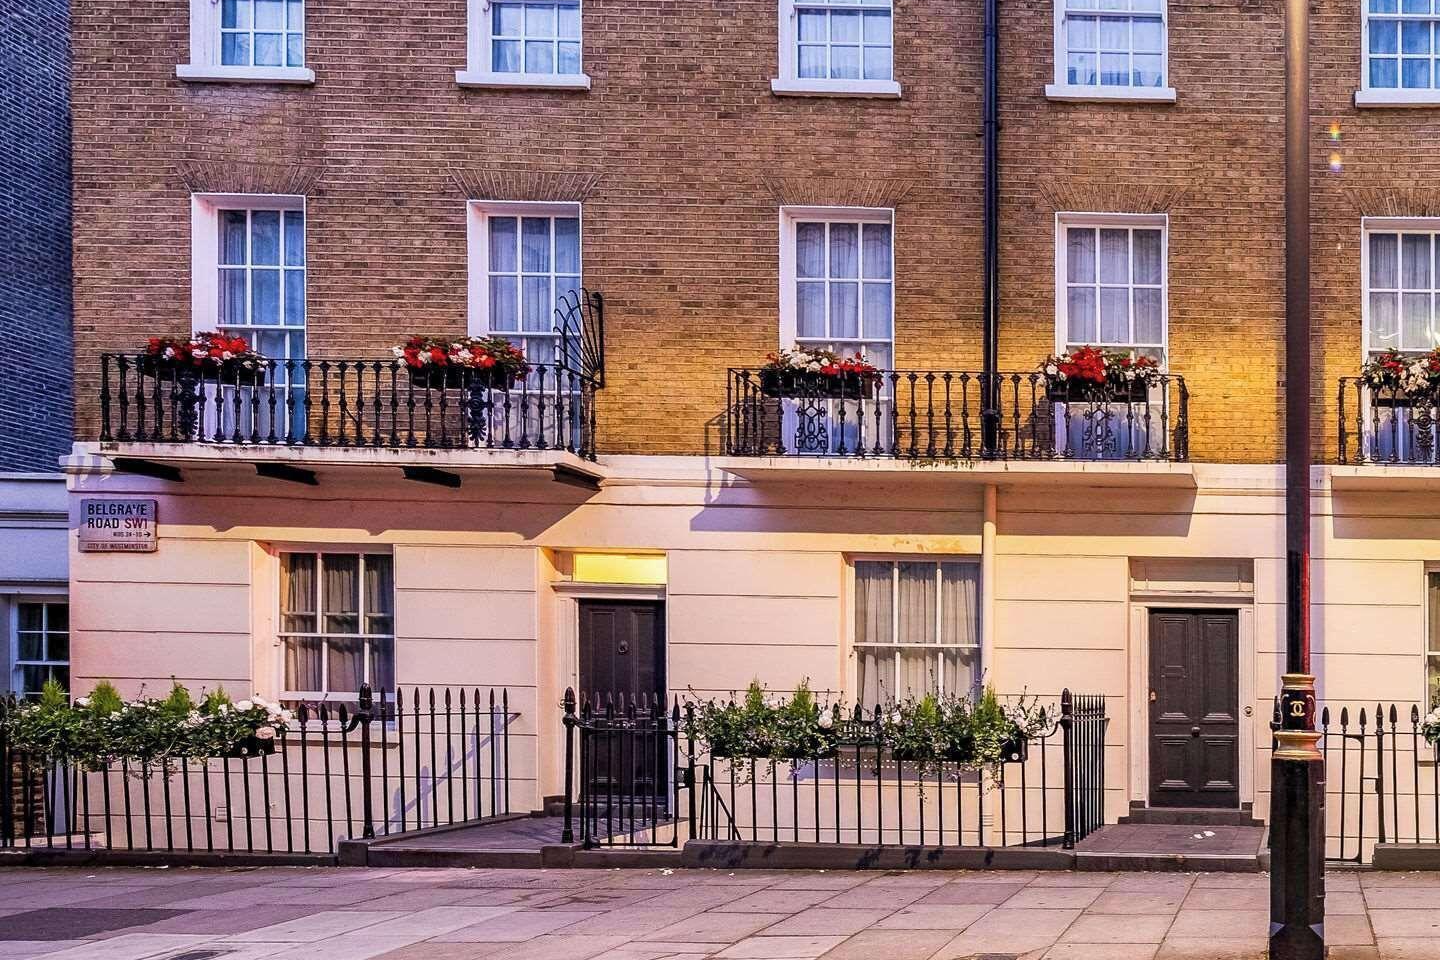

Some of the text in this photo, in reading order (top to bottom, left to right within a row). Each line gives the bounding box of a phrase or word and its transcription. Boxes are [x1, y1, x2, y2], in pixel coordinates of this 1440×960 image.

[87, 503, 147, 516] BELGRAVE
[87, 517, 148, 529] ROAD SW1
